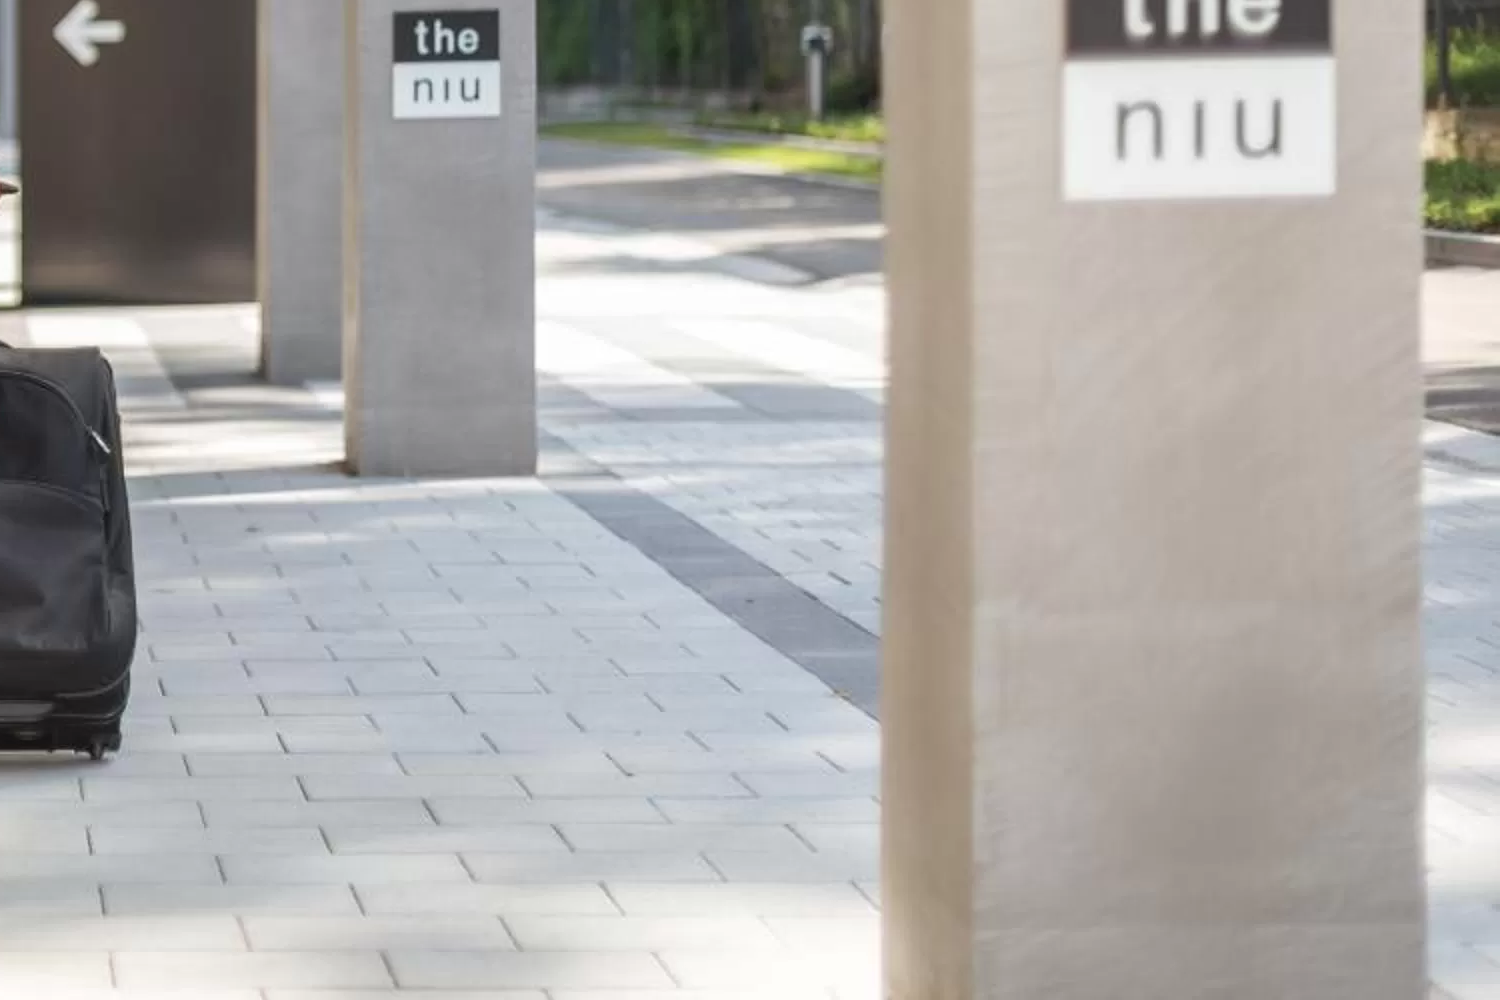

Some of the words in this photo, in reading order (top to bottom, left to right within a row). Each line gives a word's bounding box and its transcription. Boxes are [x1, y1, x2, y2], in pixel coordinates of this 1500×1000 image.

[414, 18, 480, 55] the
[413, 77, 480, 103] niu
[1116, 98, 1282, 160] niu
